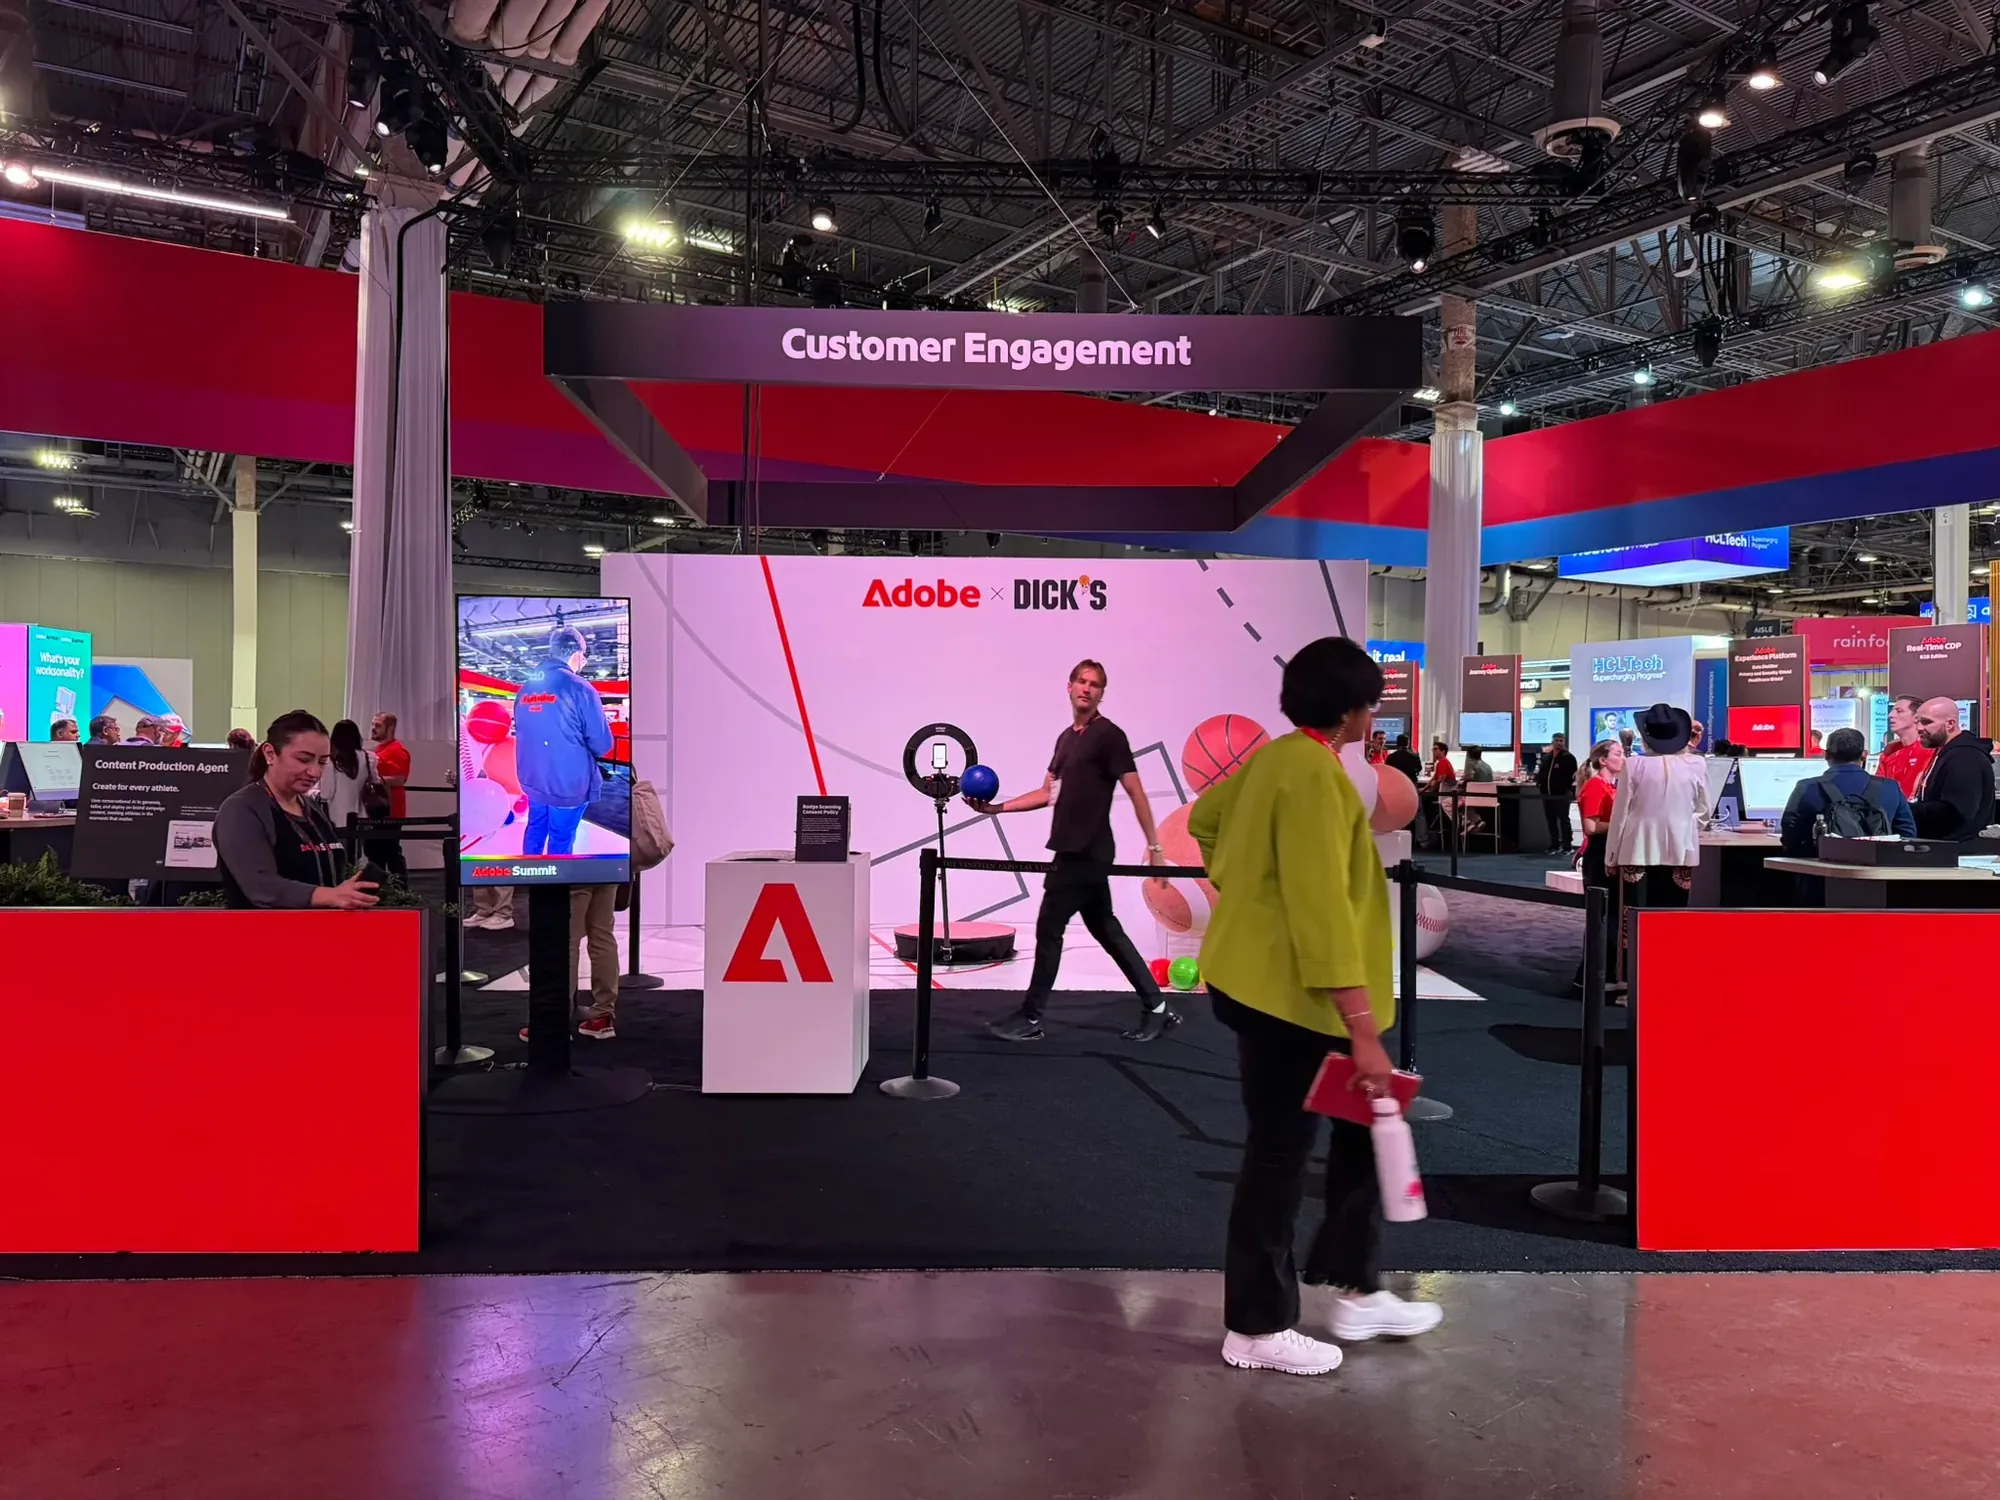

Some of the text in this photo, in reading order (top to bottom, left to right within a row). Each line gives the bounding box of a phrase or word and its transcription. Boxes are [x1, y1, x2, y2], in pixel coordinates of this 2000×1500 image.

[782, 328, 1192, 371] Customer Engagement
[862, 578, 981, 608] Adobe
[1013, 575, 1107, 610] DICK'S
[1753, 626, 1773, 634] AISLE
[1833, 634, 1888, 648] rainfo
[1906, 642, 1962, 652] Real-Time CDP
[40, 651, 80, 667] What's your
[1372, 649, 1406, 662] it real
[1734, 652, 1797, 662] Experience Platform
[1592, 654, 1664, 673] HCLTech
[35, 665, 84, 680] worksonality?
[1593, 674, 1636, 682] Supercharging
[95, 760, 229, 774] Content Production Agent
[92, 783, 117, 791] Create
[129, 785, 150, 793] every
[151, 784, 180, 792] athlete.
[472, 865, 558, 877] Adobe Summit
